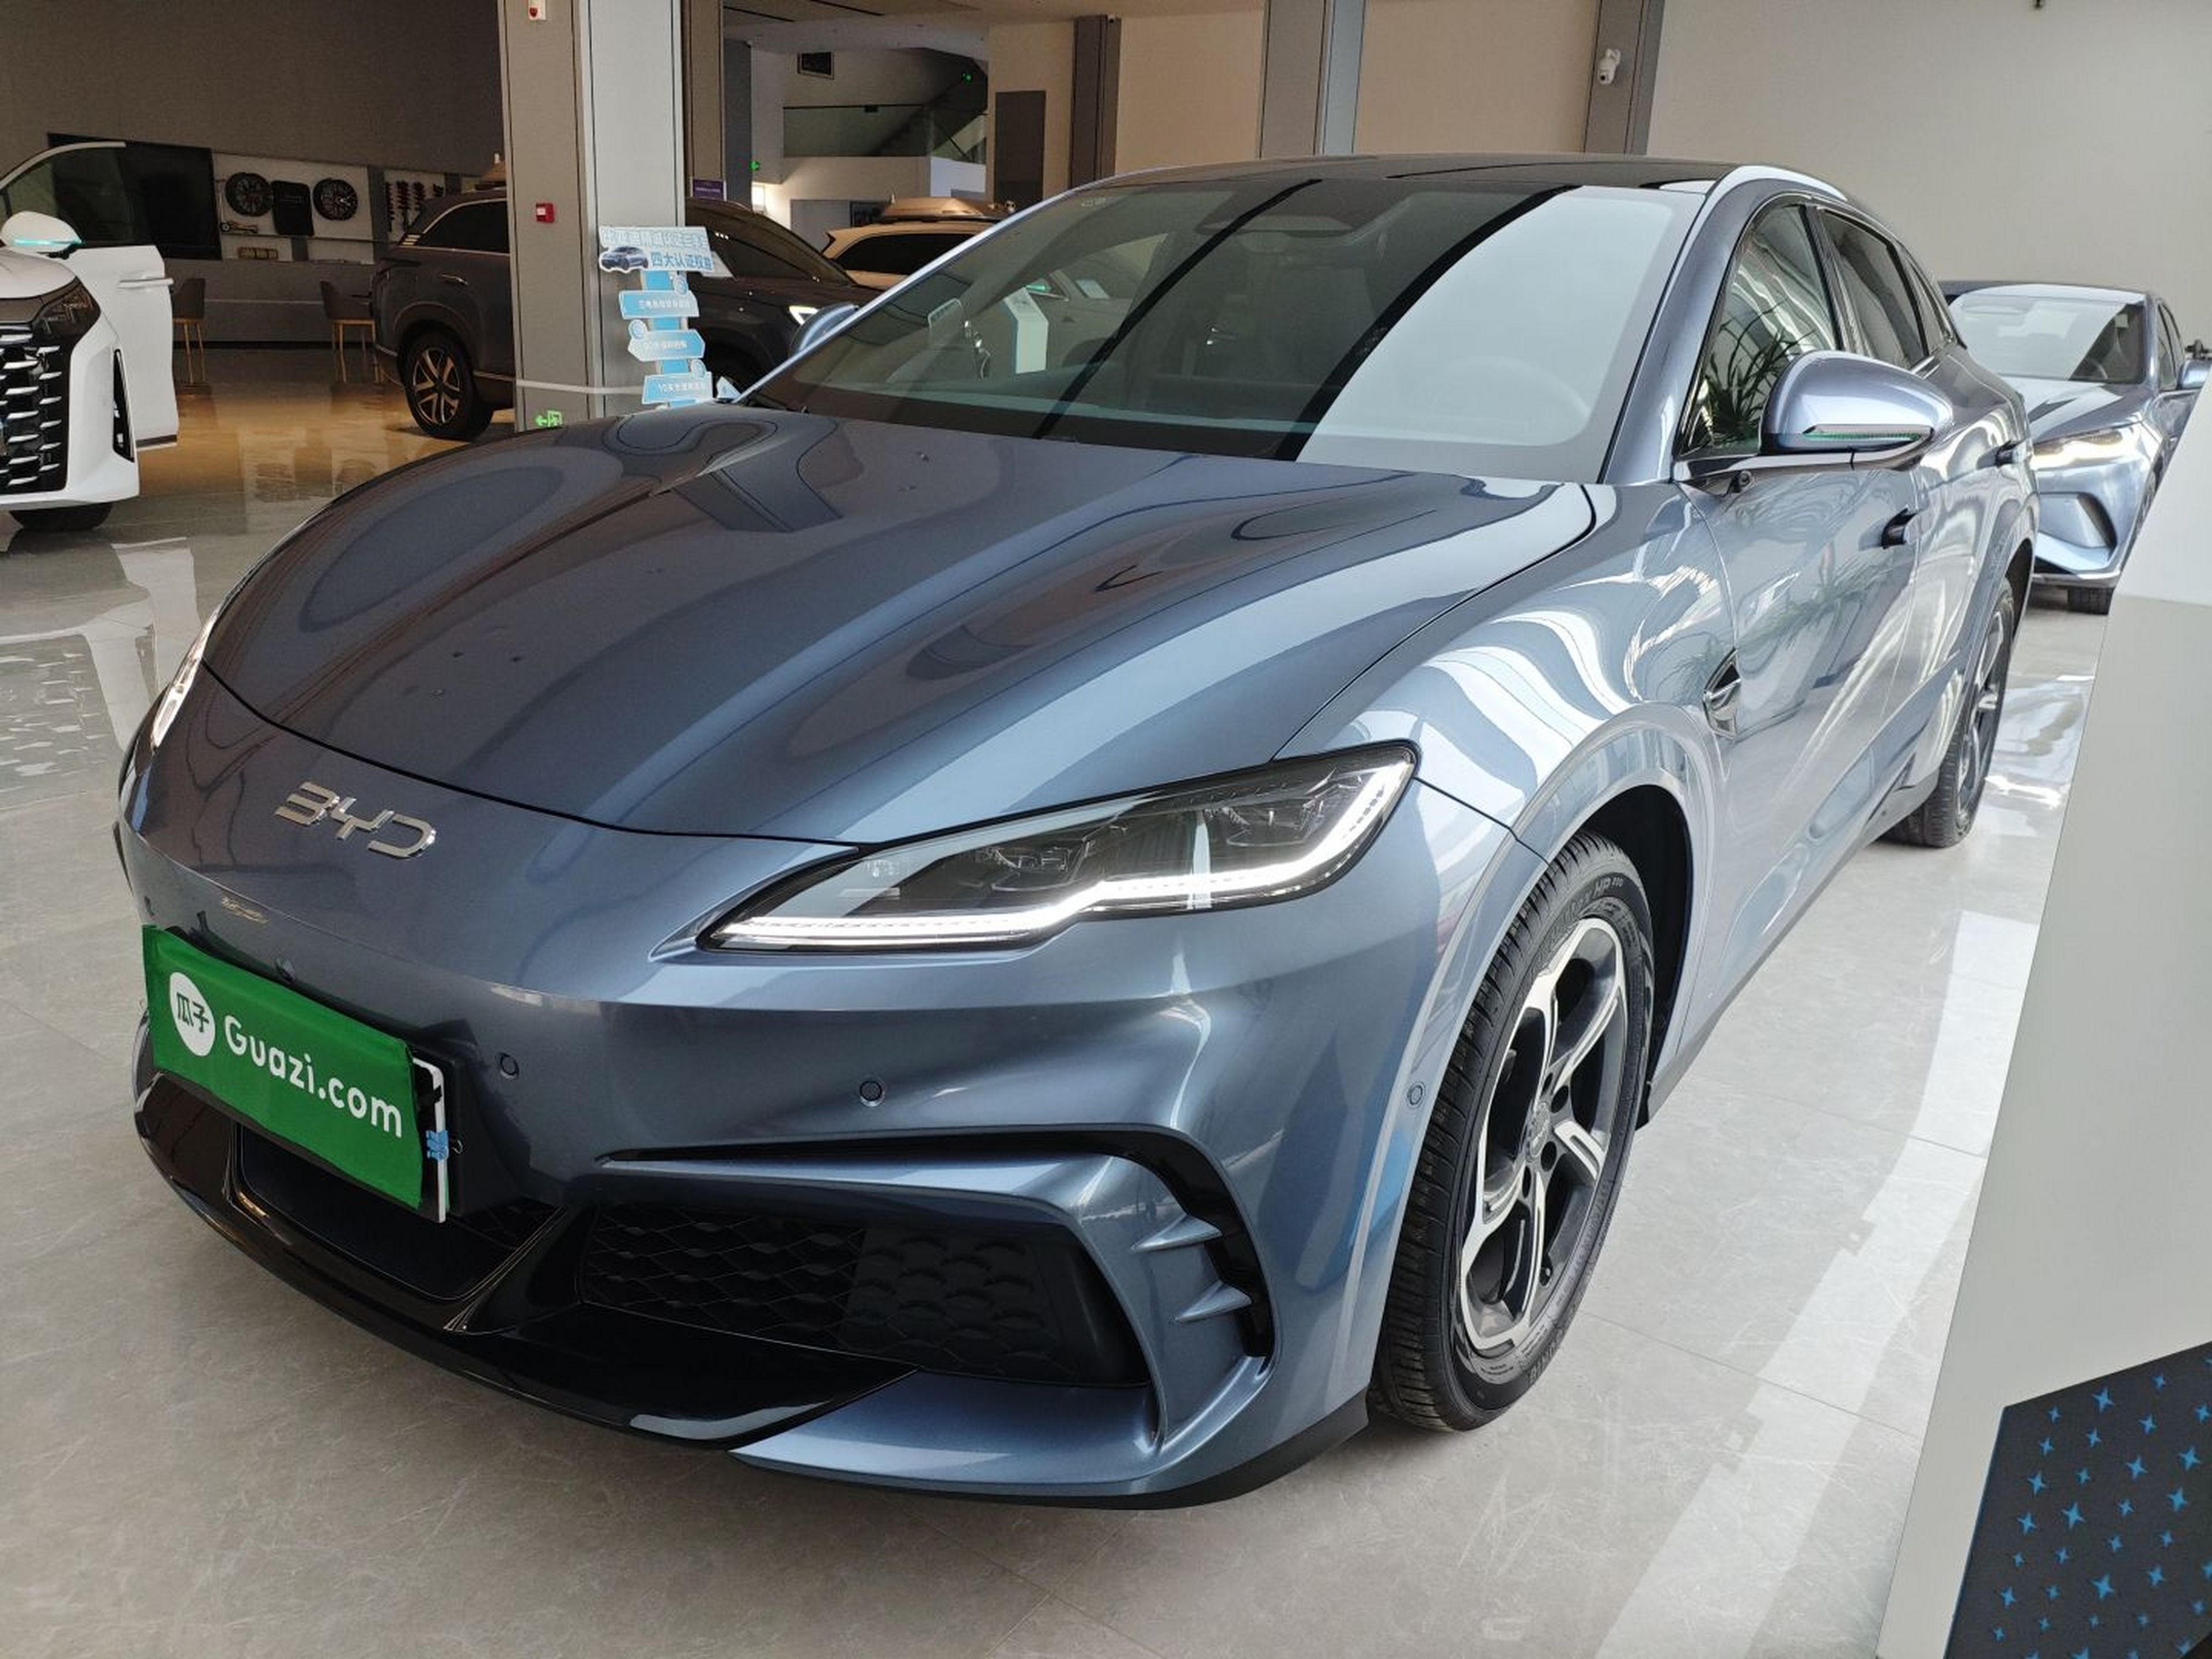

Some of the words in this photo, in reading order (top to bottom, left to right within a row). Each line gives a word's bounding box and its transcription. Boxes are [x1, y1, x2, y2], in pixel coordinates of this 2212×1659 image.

[274, 781, 436, 859] BYD
[176, 992, 210, 1033] 瓜子
[225, 1015, 402, 1138] Guazi.com
